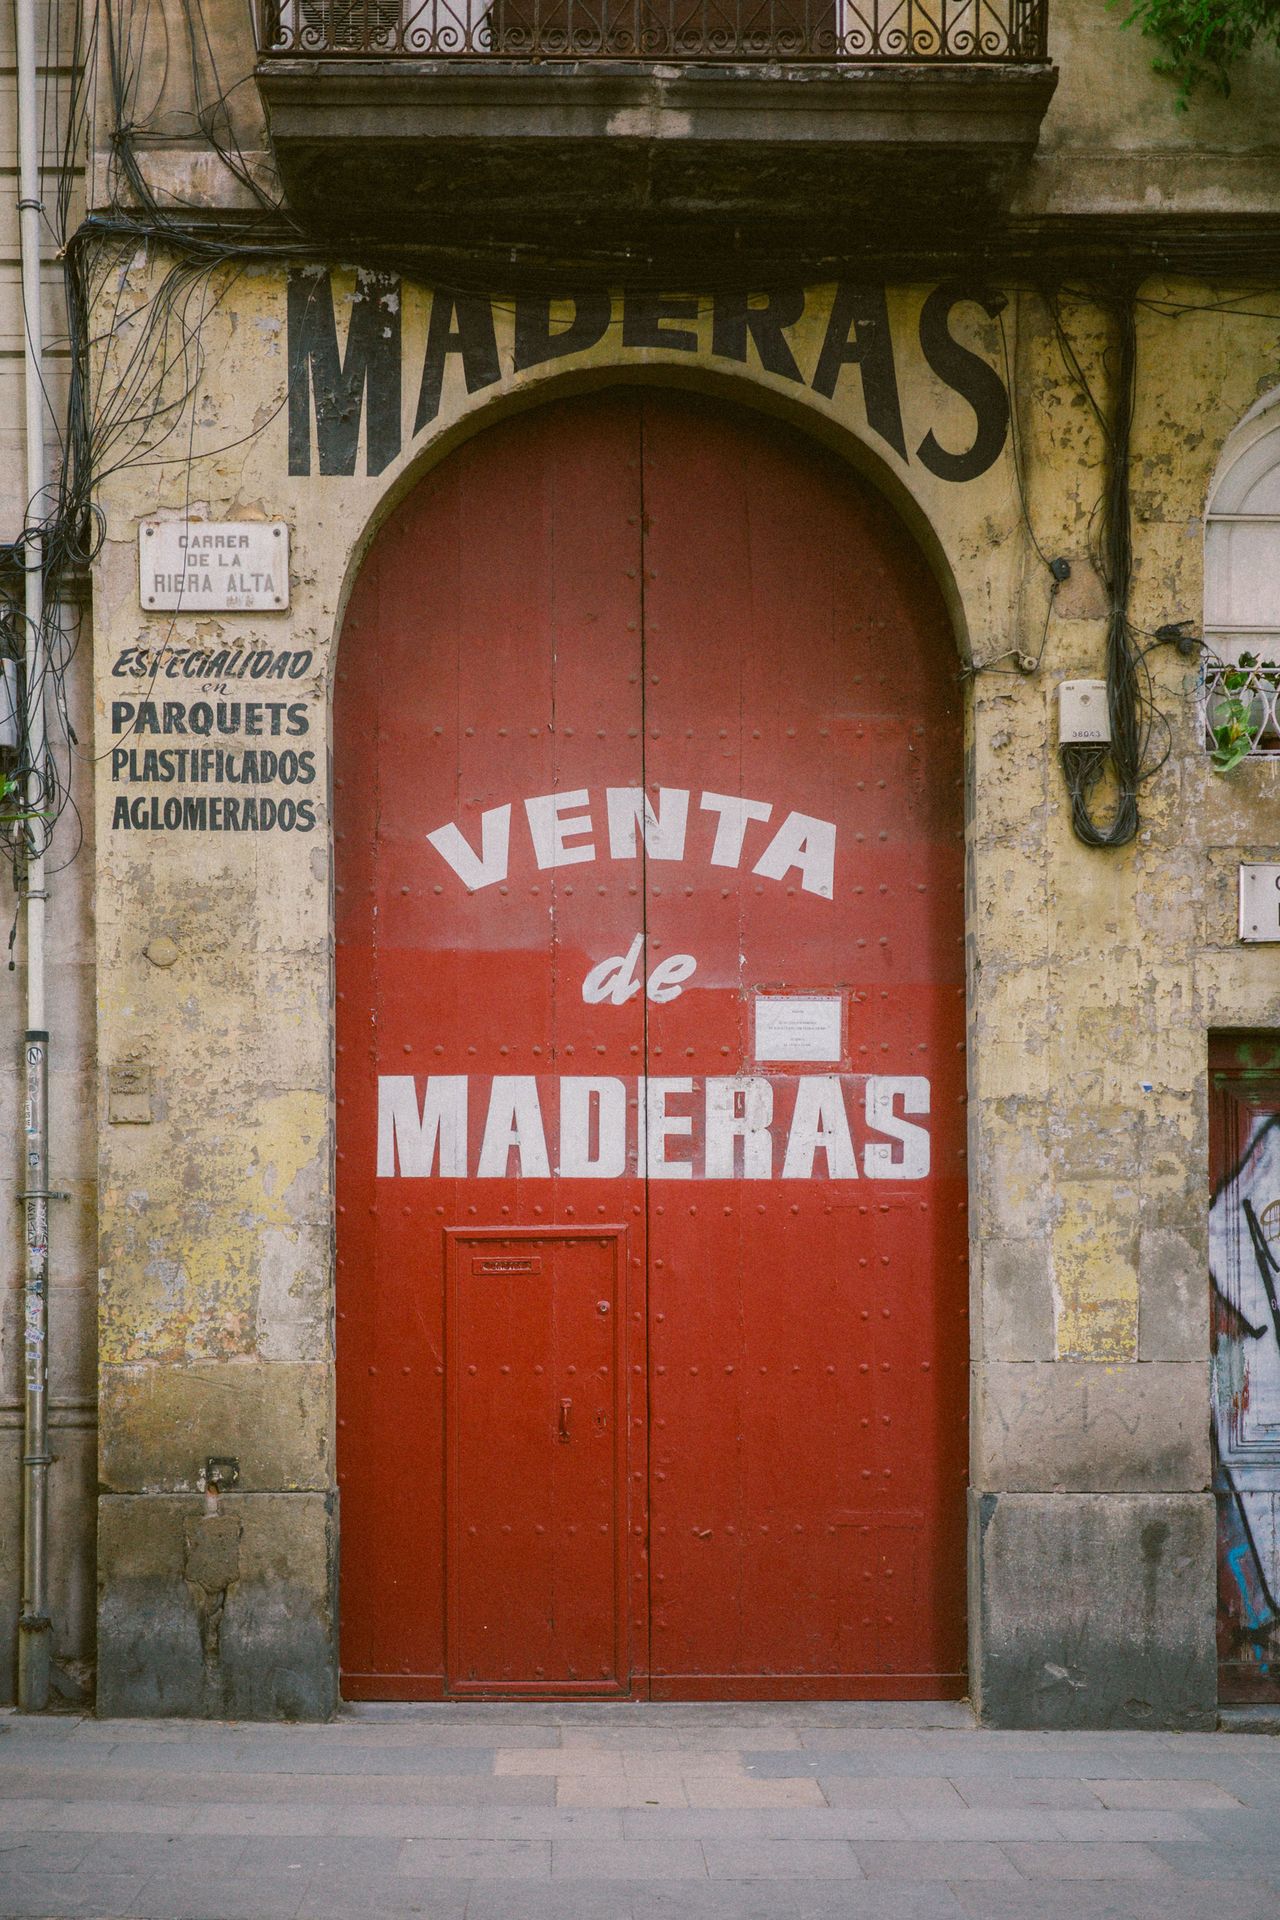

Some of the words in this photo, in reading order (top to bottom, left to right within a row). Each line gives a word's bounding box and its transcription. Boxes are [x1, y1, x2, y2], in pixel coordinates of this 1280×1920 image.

[287, 264, 1010, 482] MADERAS
[178, 535, 249, 548] CARRER
[187, 554, 209, 567] DE
[218, 554, 241, 567] LA
[154, 574, 213, 593] RIERA
[227, 574, 275, 592] ALTA
[201, 682, 232, 695] en
[111, 701, 310, 737] PARQUETS
[111, 748, 316, 784] PLASTIFICADOS
[112, 796, 316, 832] AGLOMERADOS
[426, 787, 837, 900] VENTA
[582, 933, 697, 1005] de
[376, 1075, 931, 1180] MADERAS
